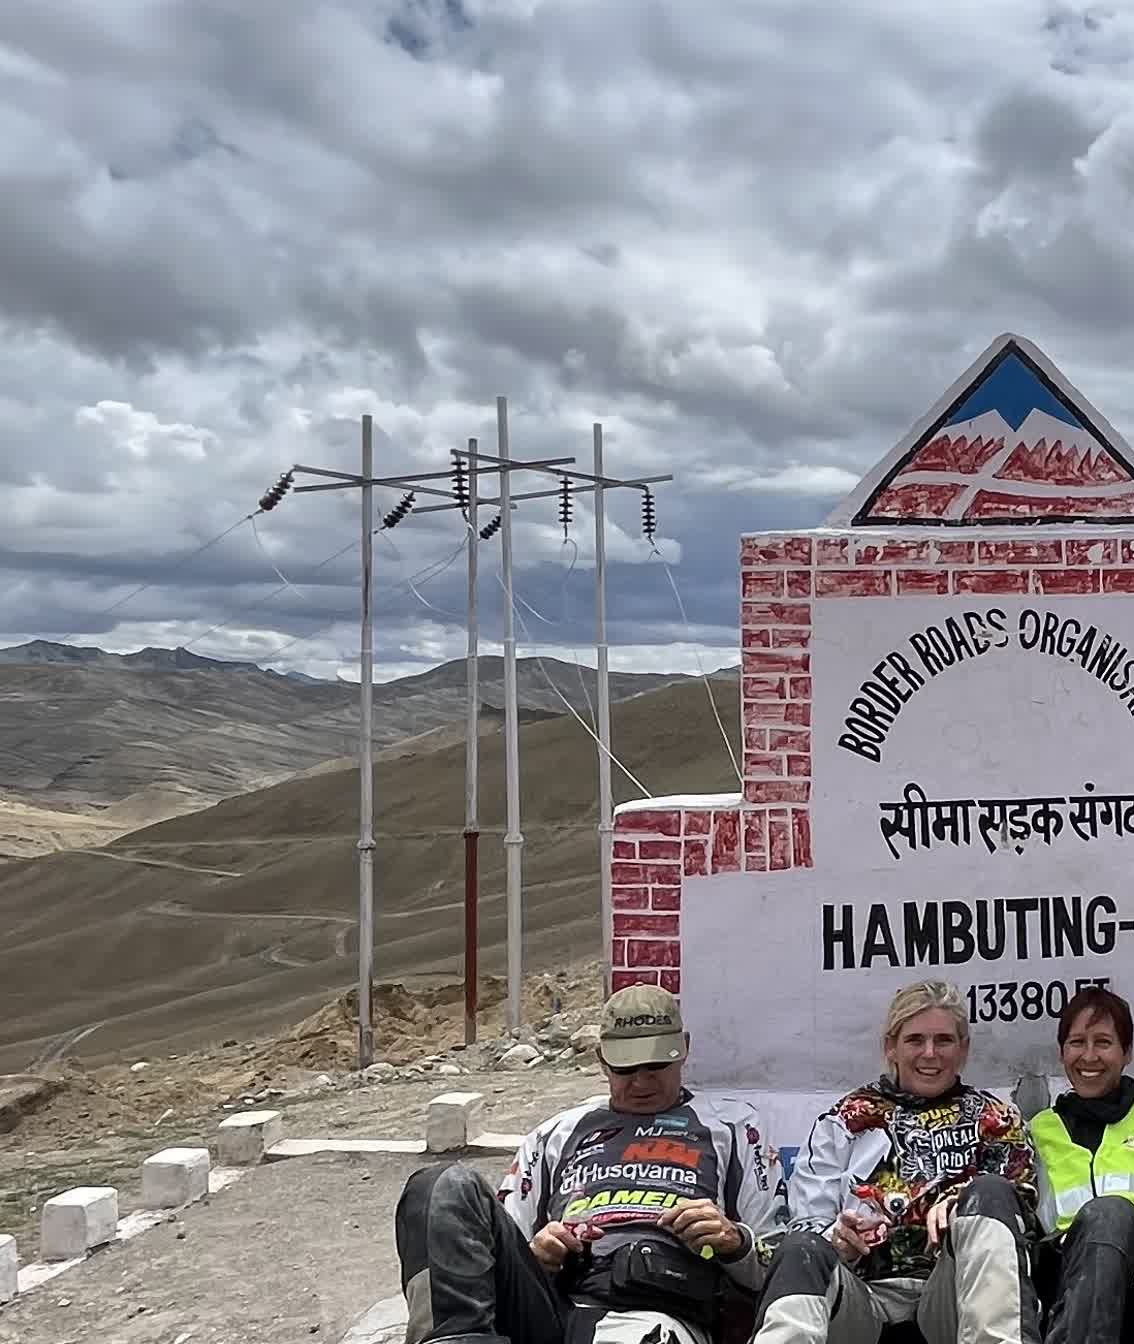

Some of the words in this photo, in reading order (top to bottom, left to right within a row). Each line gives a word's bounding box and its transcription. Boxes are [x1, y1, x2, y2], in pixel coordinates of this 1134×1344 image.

[837, 651, 926, 763] BORDER
[908, 609, 1009, 677] ROADS
[879, 782, 977, 860] सीमा
[977, 797, 1066, 855] सड़क
[966, 979, 1069, 1024] 13380
[581, 1162, 698, 1186] Husqvarna
